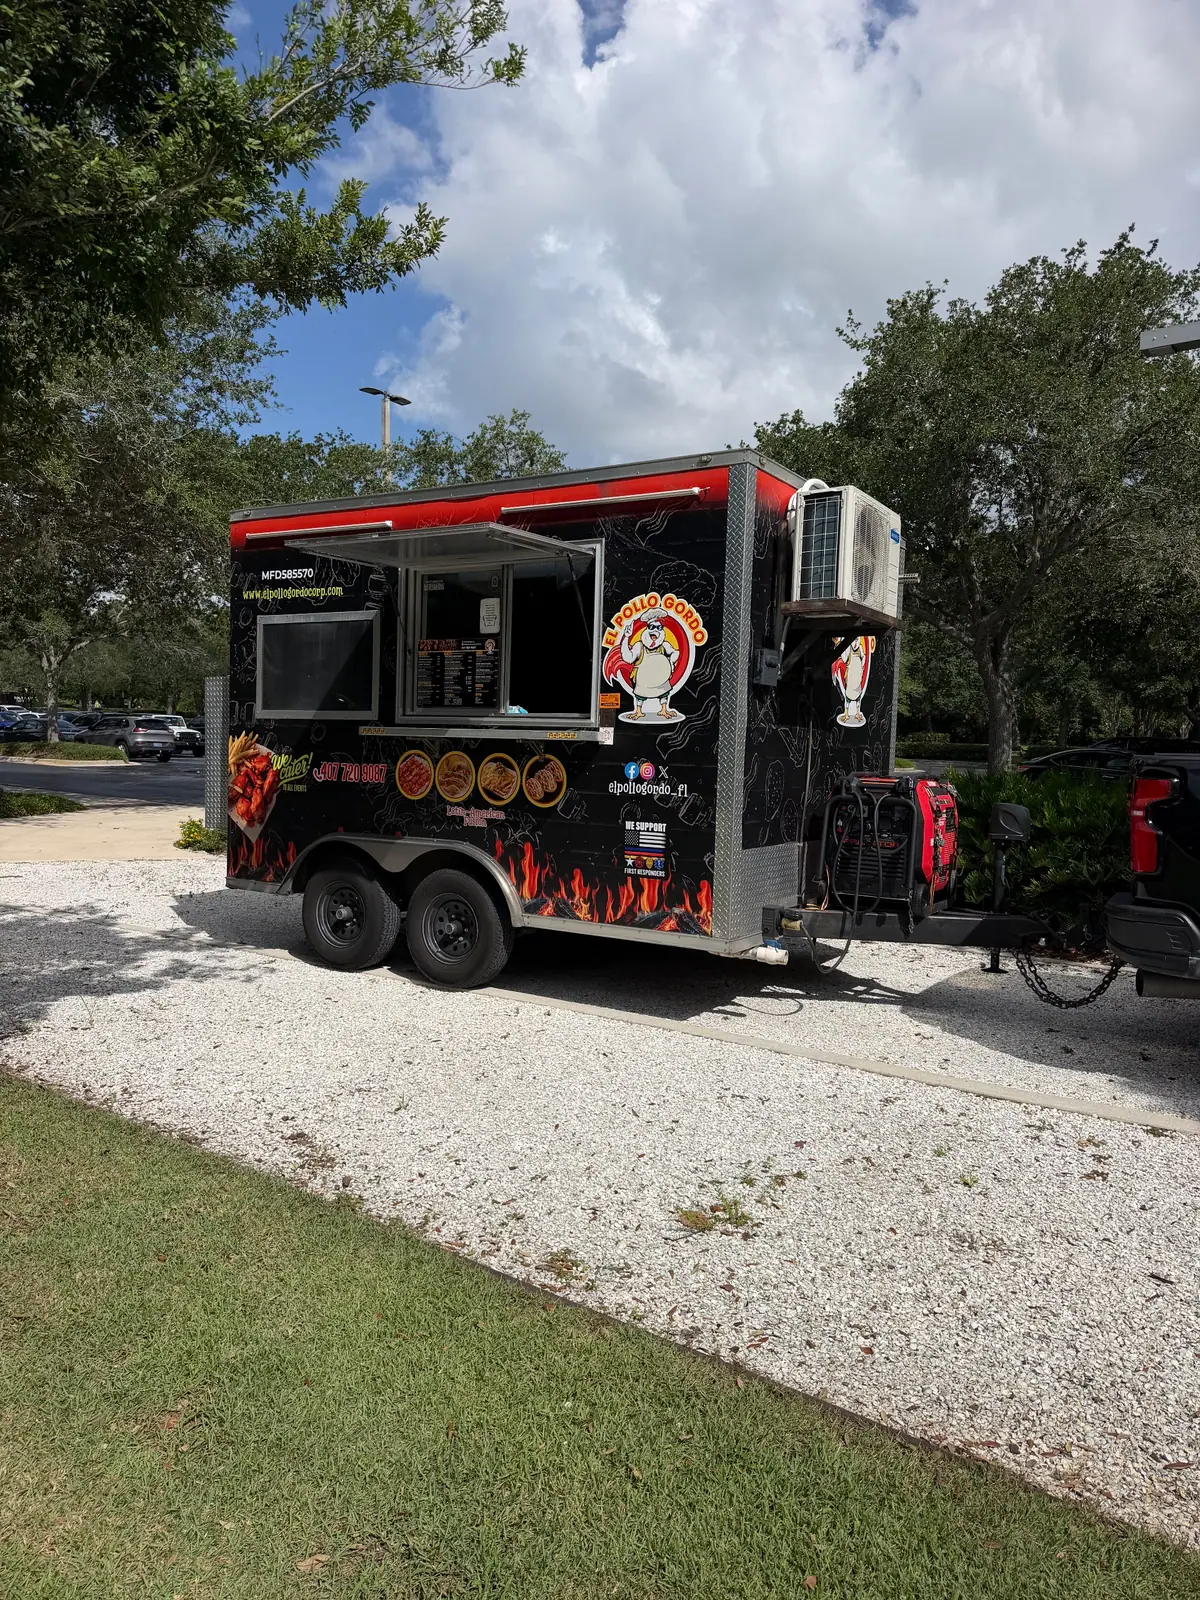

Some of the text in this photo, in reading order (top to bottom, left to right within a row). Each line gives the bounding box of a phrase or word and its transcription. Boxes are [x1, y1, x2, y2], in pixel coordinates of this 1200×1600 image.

[261, 568, 314, 580] MFD585570
[242, 586, 344, 602] www.elpollogordocorp.com
[603, 593, 707, 648] EL POLLO GORDO
[271, 753, 293, 771] We
[319, 762, 387, 783] 407 720 9087
[608, 780, 688, 797] elpollogordo_fl
[625, 820, 667, 832] WE SUPPORT
[624, 867, 666, 877] FIRST RESPONDERS
